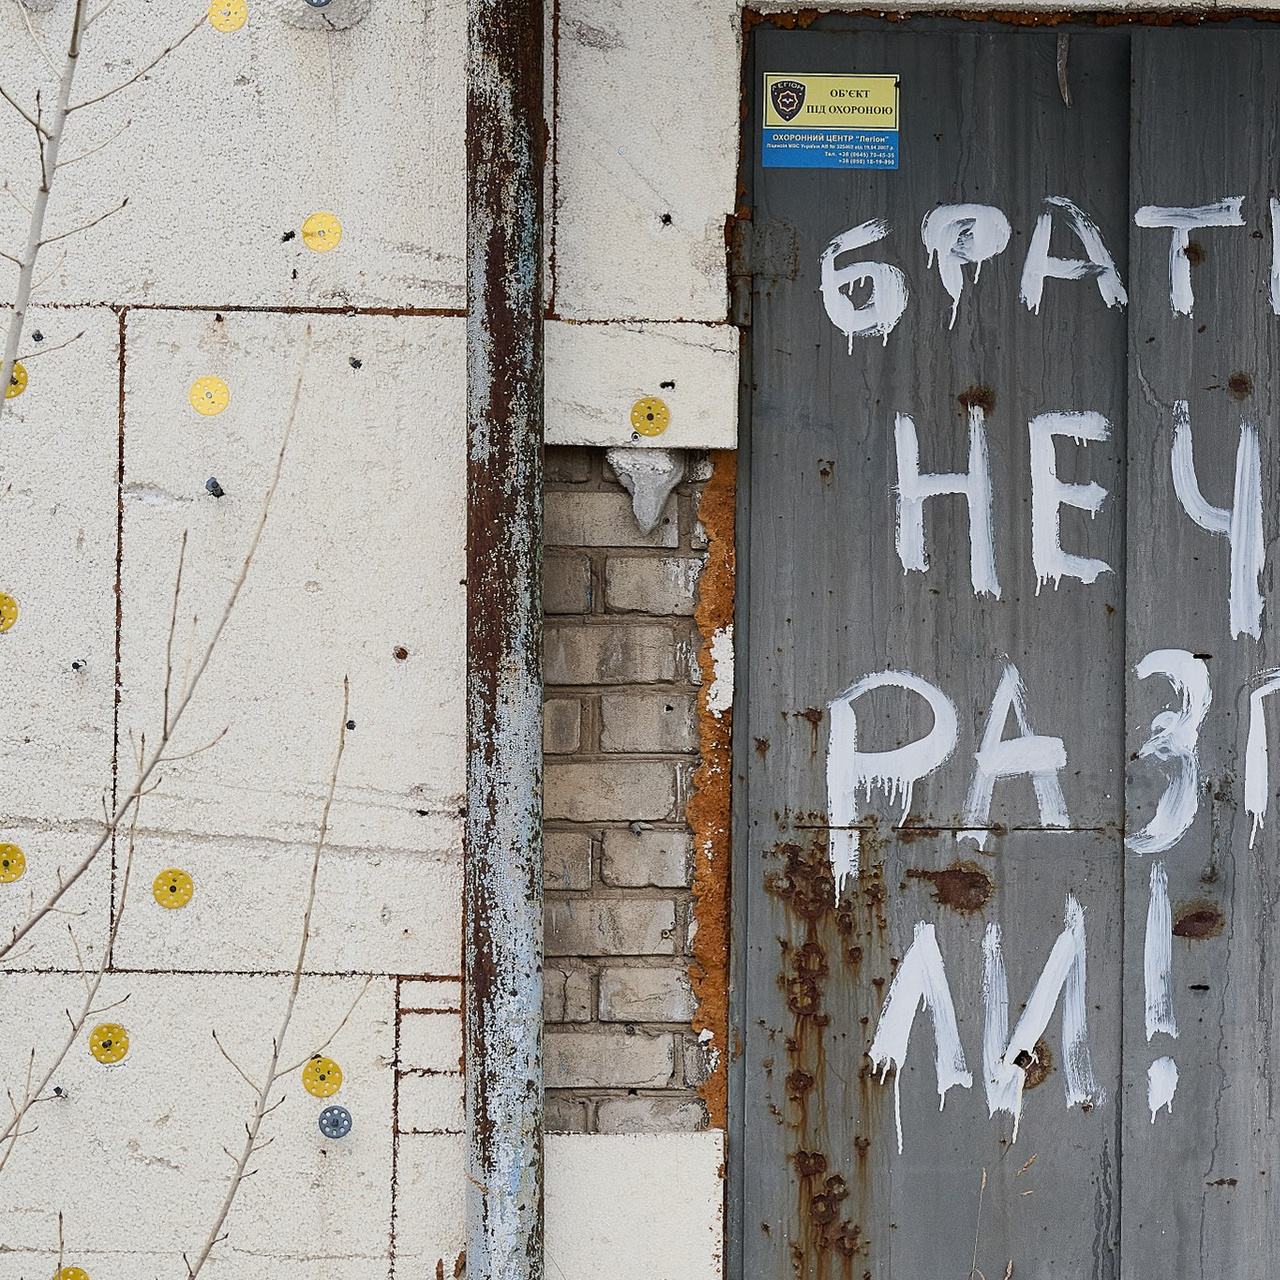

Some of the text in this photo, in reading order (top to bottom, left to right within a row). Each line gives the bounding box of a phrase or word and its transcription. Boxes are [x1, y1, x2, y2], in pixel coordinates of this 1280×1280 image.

[806, 105, 893, 115] ПІД ОХОРОНОЮ
[772, 133, 824, 142] ОХОРОННИЙ
[826, 135, 854, 143] ЦЕНТР
